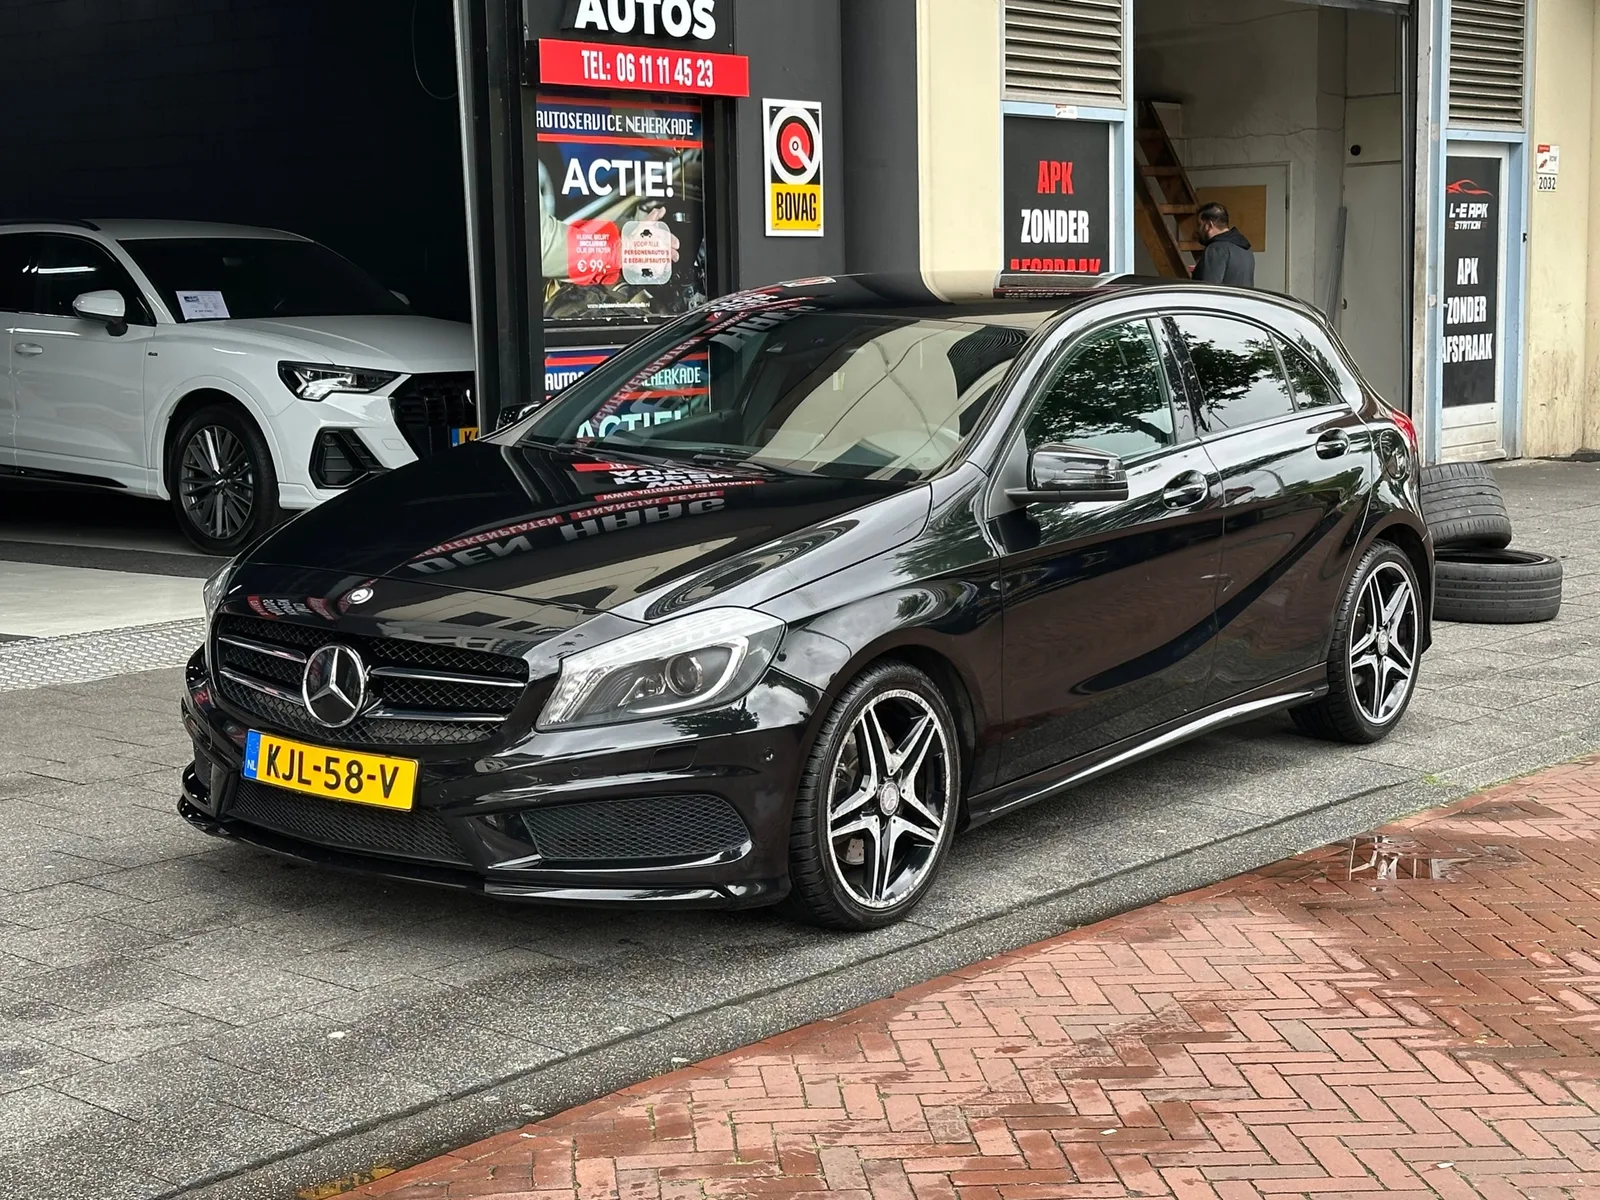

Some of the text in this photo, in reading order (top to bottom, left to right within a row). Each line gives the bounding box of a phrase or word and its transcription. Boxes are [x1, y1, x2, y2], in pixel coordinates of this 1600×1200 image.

[574, 0, 716, 40] AUTOS
[581, 50, 714, 88] TEL: 06 11 11 45 23
[536, 110, 694, 136] AUTOSERVICE NEHERKADE
[561, 158, 674, 198] ACTIE!
[1037, 160, 1074, 194] APK
[1538, 176, 1556, 190] 2032
[775, 191, 818, 222] BOVAG
[1449, 202, 1489, 218] L-E APK
[1020, 208, 1090, 243] ZONDER
[1457, 257, 1480, 285] APK
[1446, 296, 1487, 325] ZONDER
[1442, 333, 1494, 364] AFSPRAAK
[246, 759, 257, 771] NL
[266, 743, 400, 799] KJL-58-V
